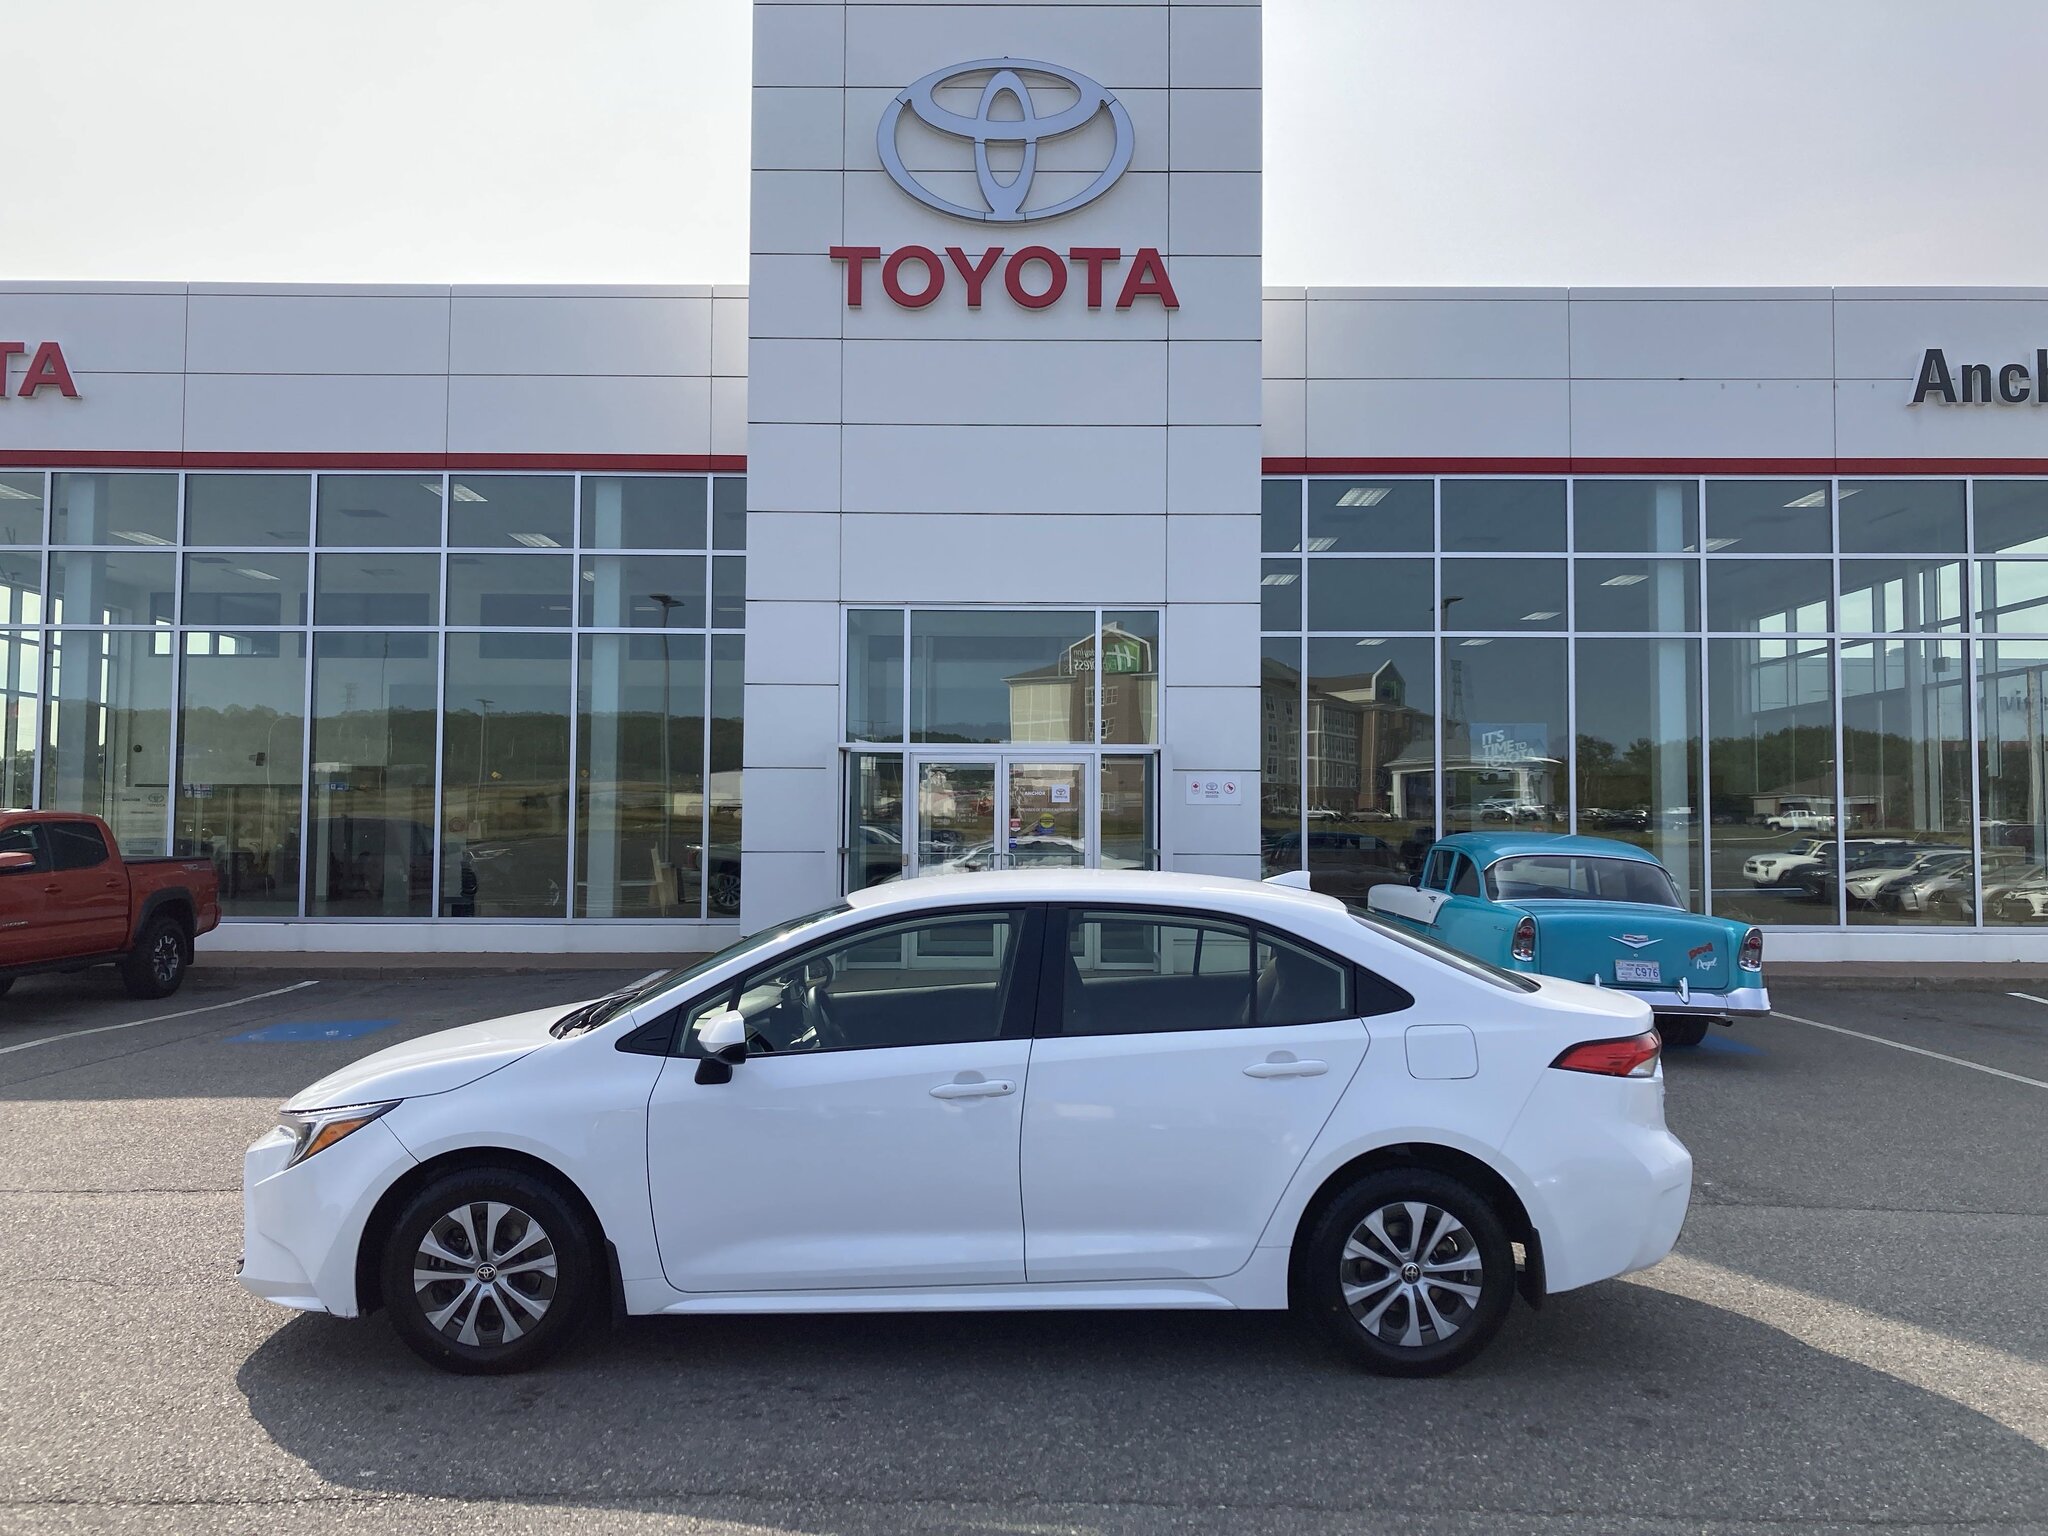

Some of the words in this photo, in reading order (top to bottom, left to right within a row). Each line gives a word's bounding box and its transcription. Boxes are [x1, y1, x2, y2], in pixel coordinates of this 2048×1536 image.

[829, 245, 1180, 310] TOYOTA
[1482, 739, 1515, 756] TIME
[1515, 741, 1527, 750] TO
[1483, 747, 1536, 768] TOYOTA
[1635, 967, 1659, 977] C976
